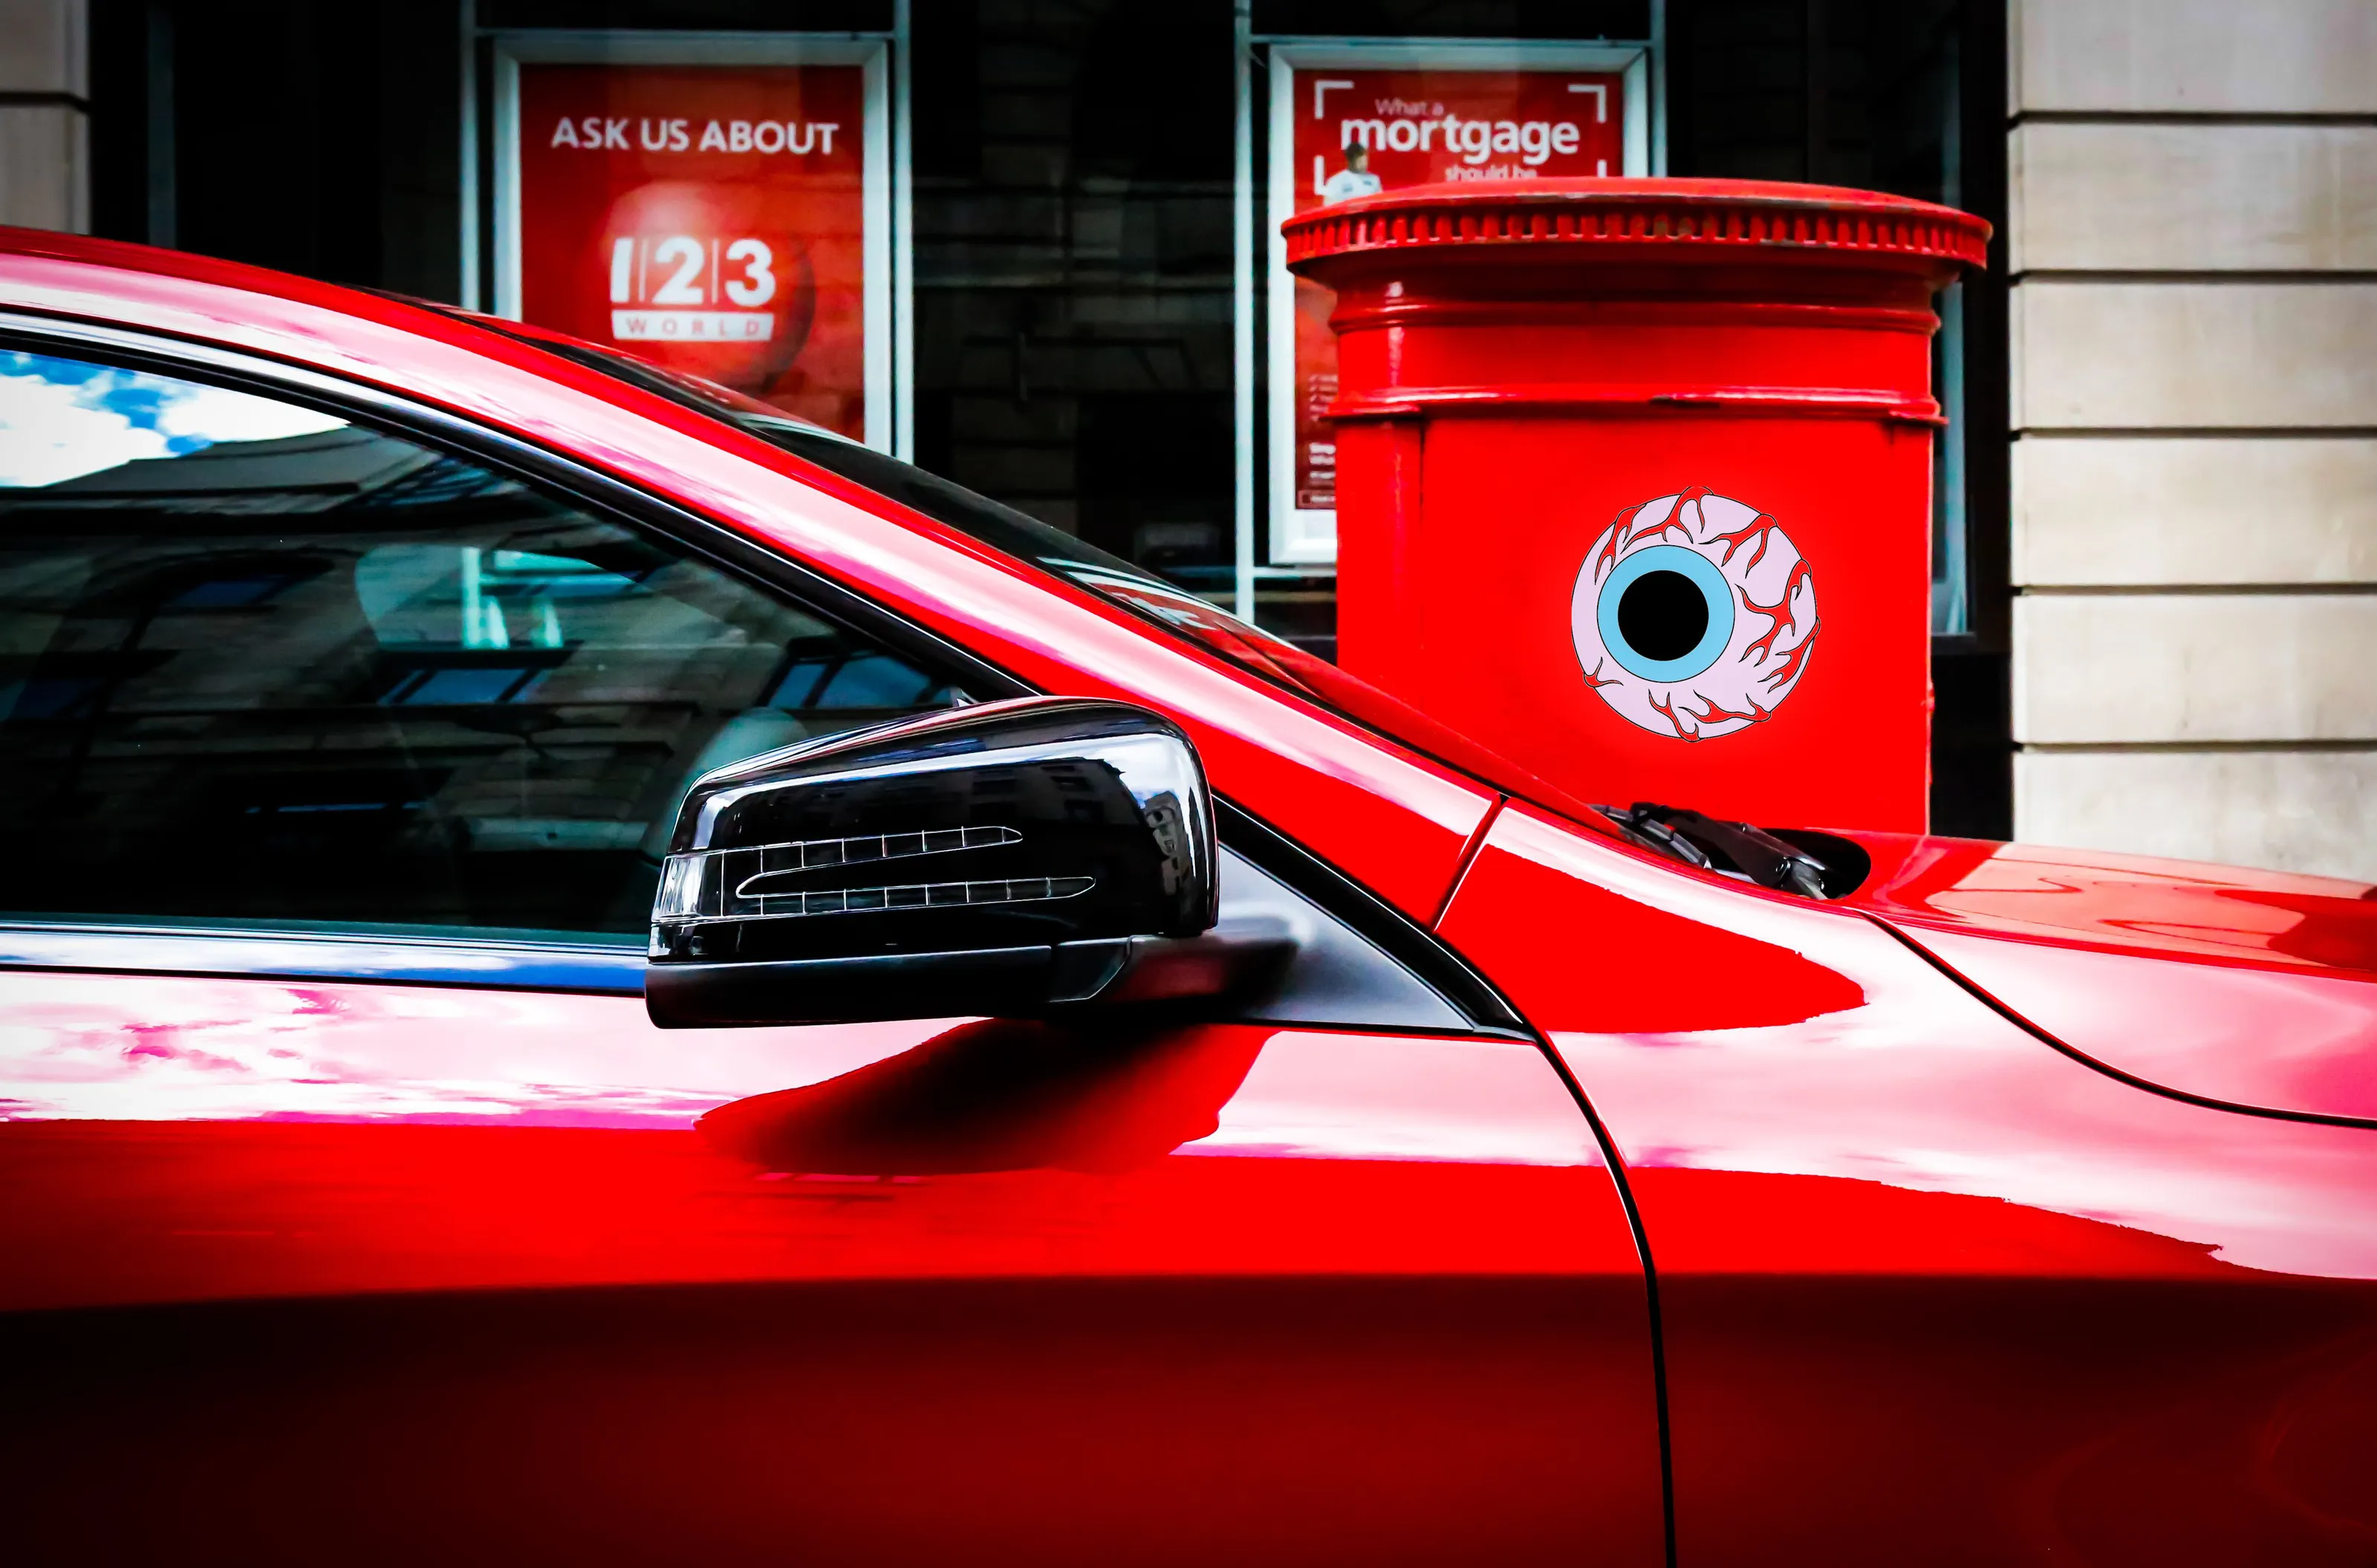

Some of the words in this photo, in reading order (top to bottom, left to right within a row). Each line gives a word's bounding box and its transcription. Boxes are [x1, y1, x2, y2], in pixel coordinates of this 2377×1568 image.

[1375, 98, 1428, 117] What
[1431, 103, 1444, 117] a
[551, 117, 631, 150] ASK
[640, 119, 689, 152] US
[699, 121, 839, 155] ABOUT
[1340, 114, 1580, 165] mortgage
[625, 316, 761, 336] WORLD
